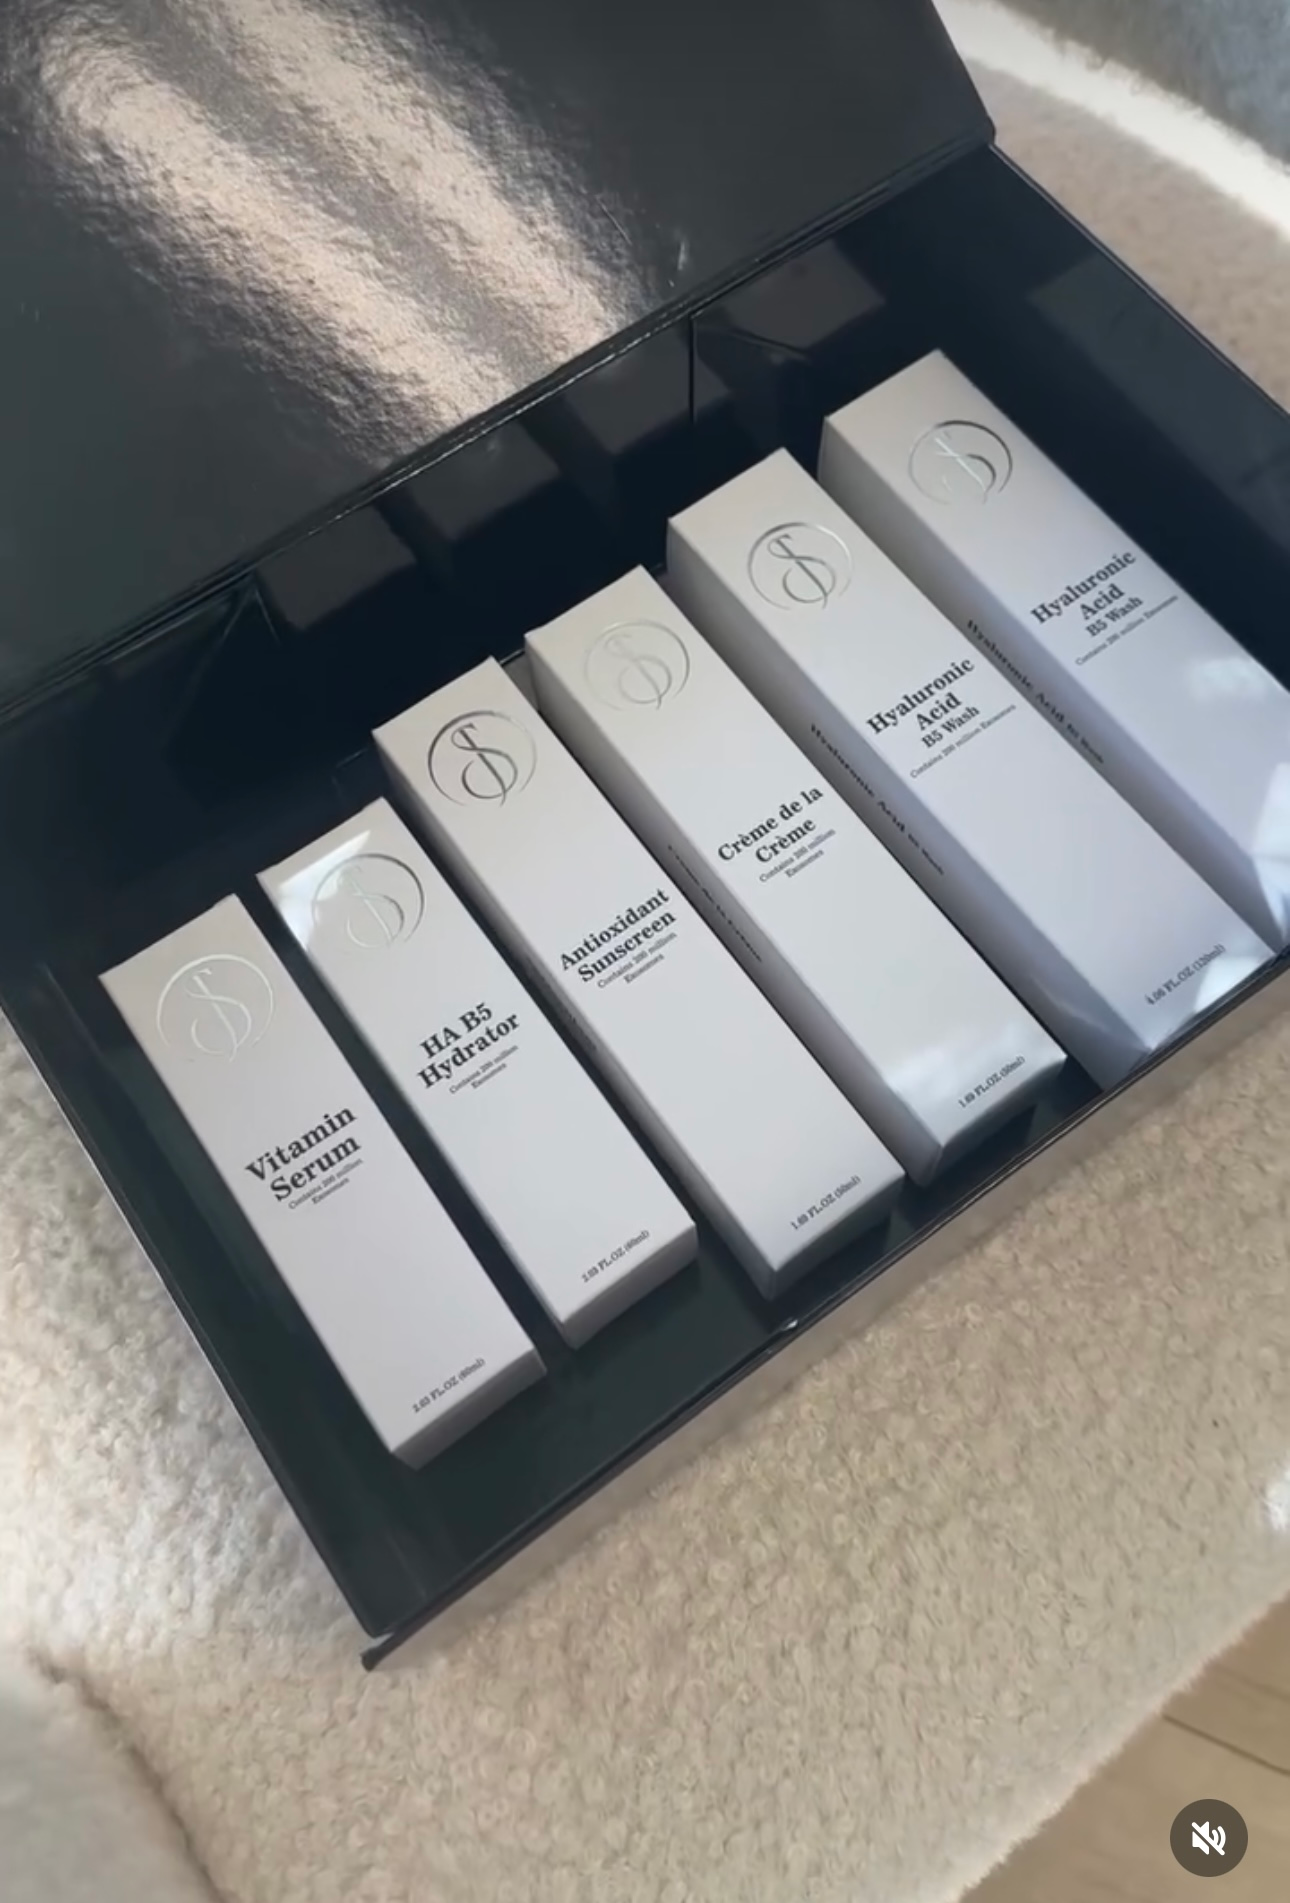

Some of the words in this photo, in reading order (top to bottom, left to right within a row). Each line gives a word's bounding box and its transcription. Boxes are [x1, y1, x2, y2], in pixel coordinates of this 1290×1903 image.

[1030, 552, 1137, 624] Hyaluronic
[1079, 583, 1126, 621] Acid
[1085, 619, 1108, 638] B5
[1105, 596, 1144, 623] Wash
[866, 659, 975, 735] Hyaluronic
[915, 692, 963, 731] Acid
[921, 730, 944, 749] B5
[941, 705, 980, 733] Wash
[718, 817, 779, 861] Crème
[779, 803, 803, 821] de
[800, 788, 824, 805] la
[755, 819, 816, 863] Crème
[560, 888, 669, 971] Antioxidant
[578, 912, 676, 982] Sunscreen
[416, 1014, 520, 1089] Hydrator
[419, 1026, 462, 1059] HA
[458, 1002, 493, 1033] B5
[244, 1108, 357, 1181] Vitamin
[270, 1137, 361, 1202] Serum
